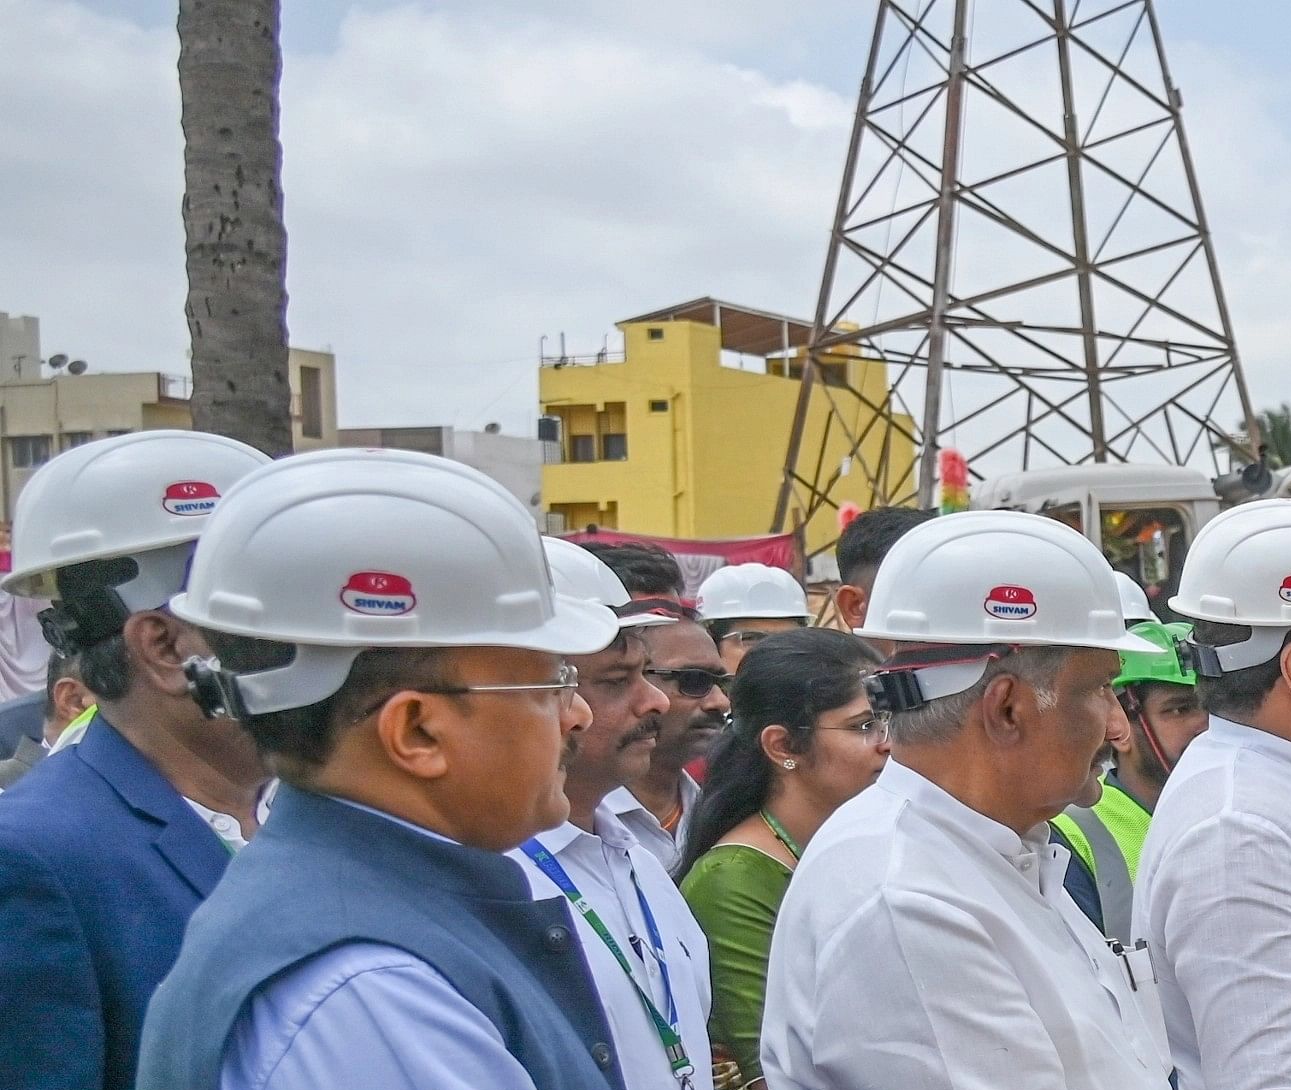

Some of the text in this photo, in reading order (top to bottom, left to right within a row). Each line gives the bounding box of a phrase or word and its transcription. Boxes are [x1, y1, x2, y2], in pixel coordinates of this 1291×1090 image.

[174, 502, 215, 512] SHIVAM
[354, 598, 406, 610] SHIVAM
[993, 606, 1029, 614] SHIVAM
